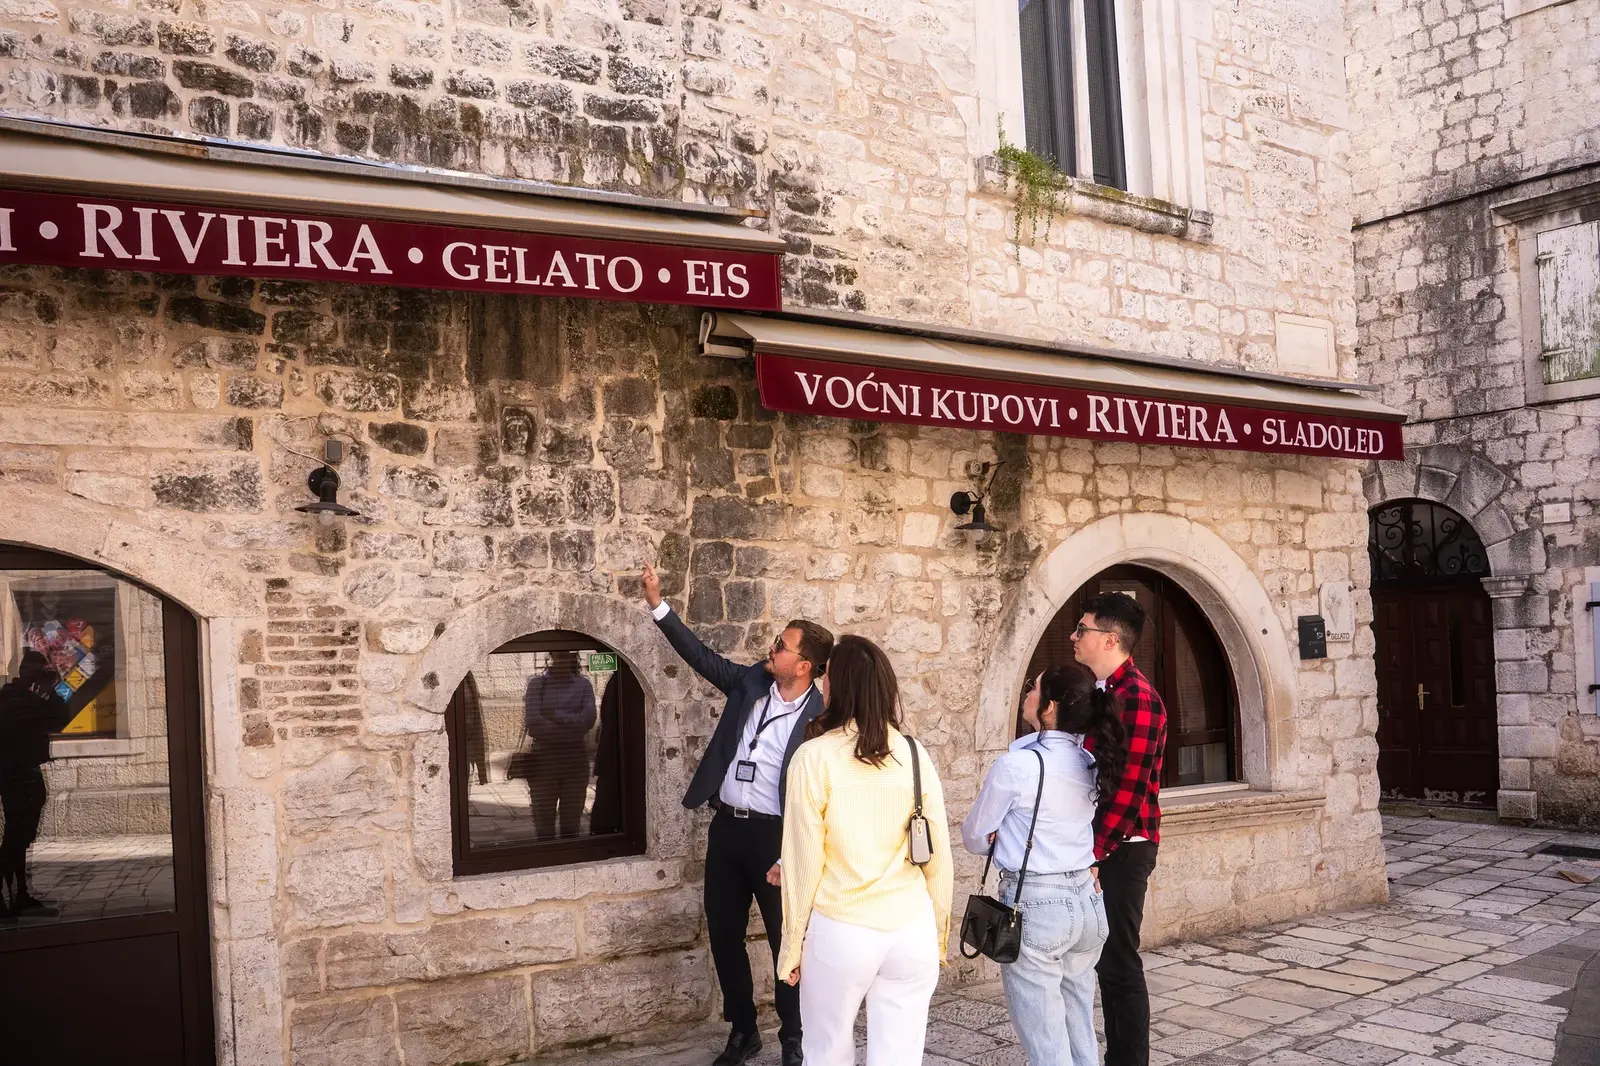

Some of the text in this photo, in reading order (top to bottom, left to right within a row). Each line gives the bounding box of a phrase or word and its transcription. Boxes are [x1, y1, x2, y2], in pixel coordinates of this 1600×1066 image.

[77, 203, 392, 275] RIVIERA
[442, 241, 643, 294] GELATO
[683, 259, 749, 299] EIS
[794, 371, 1384, 455] VOĆNI KUPOVI RIVIERA SLADOLED
[1331, 632, 1350, 640] GELATO
